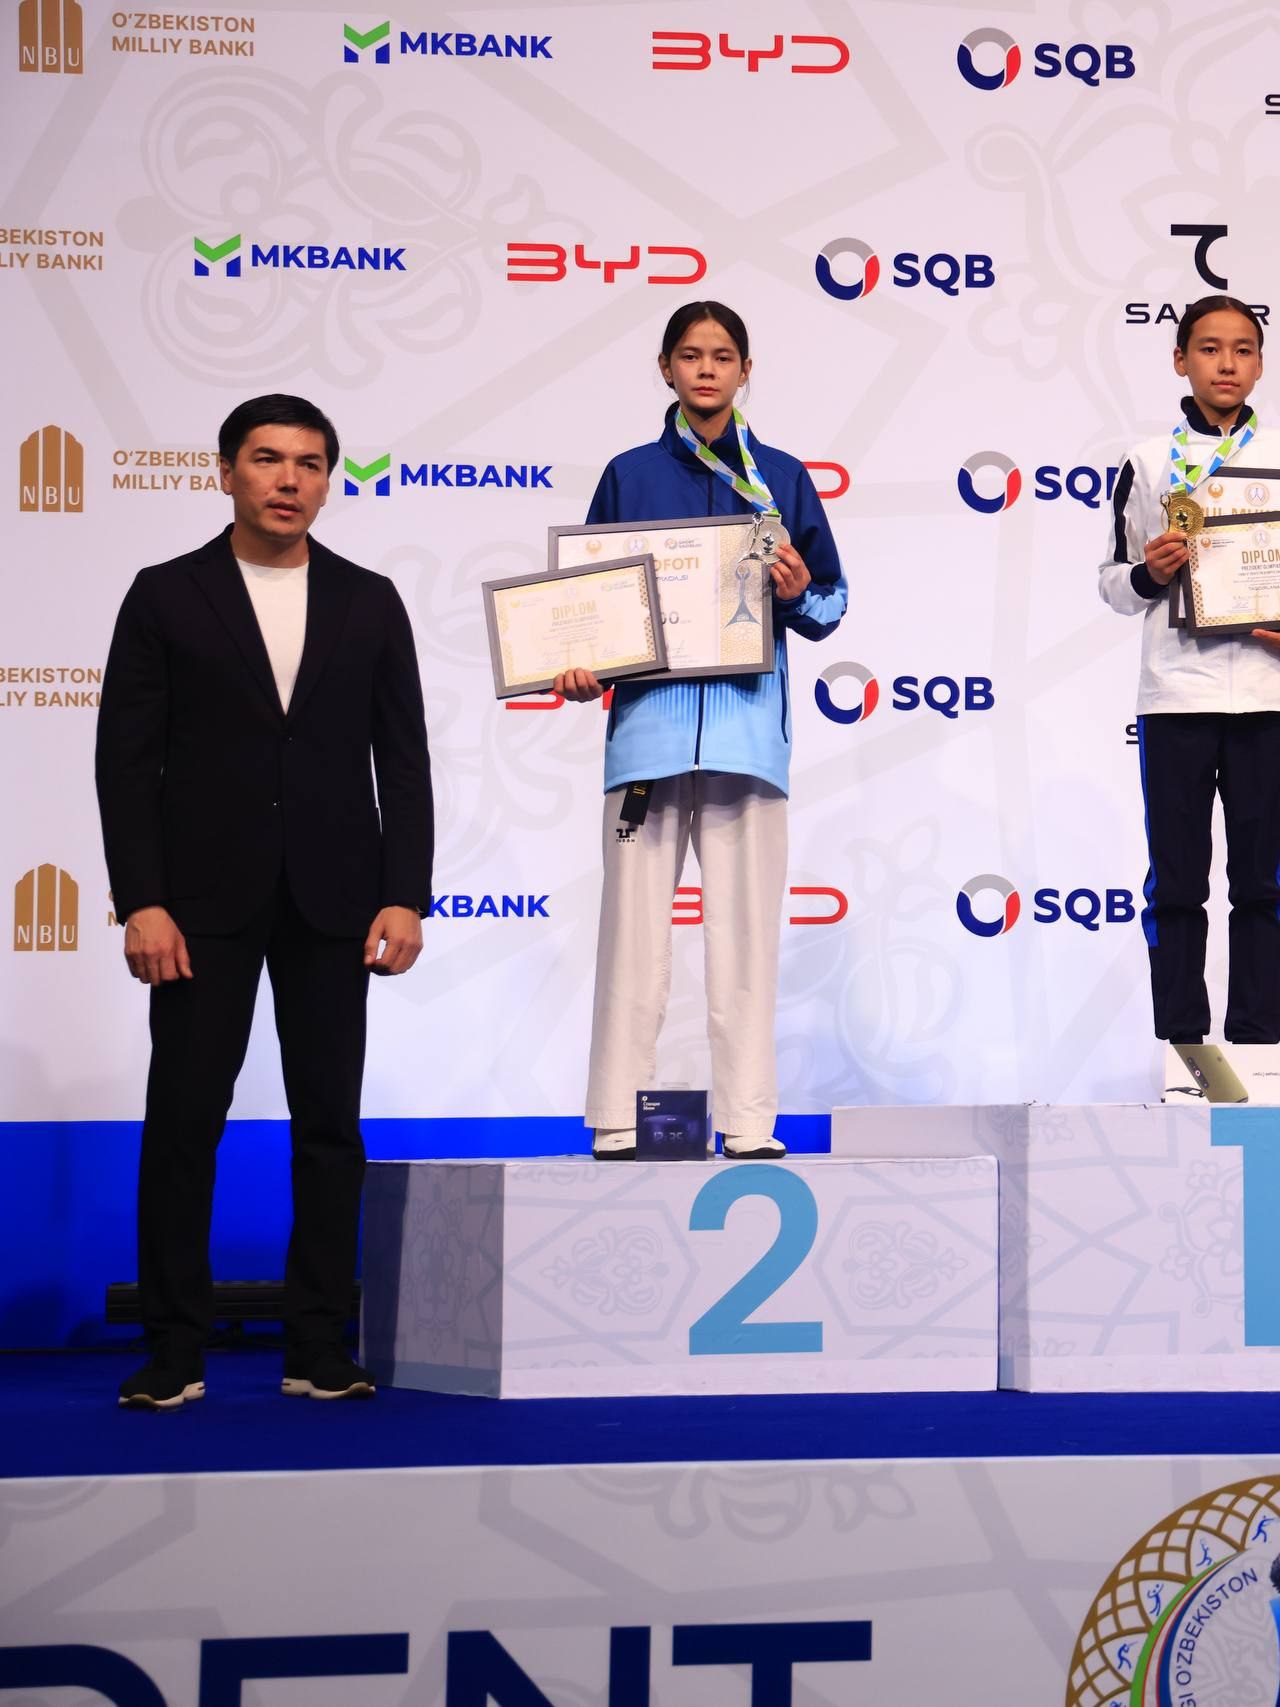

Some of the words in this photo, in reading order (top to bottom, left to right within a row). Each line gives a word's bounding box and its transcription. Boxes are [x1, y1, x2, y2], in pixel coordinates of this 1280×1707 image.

[112, 12, 254, 32] O'ZBEKISTON
[22, 45, 81, 68] NBU
[112, 36, 182, 53] MILLIY
[190, 39, 253, 56] BANKI
[401, 32, 552, 58] MKBANK
[652, 32, 849, 74] BYD
[1035, 43, 1135, 87] SQB
[37, 253, 102, 270] BANKI
[252, 245, 406, 270] MKBANK
[507, 243, 707, 284] BYD
[894, 253, 995, 296] SQB
[1126, 303, 1270, 325] SAR
[113, 450, 221, 468] O'ZBEKIST
[113, 474, 183, 490] MILLIY
[401, 464, 553, 488] MKBANK
[23, 484, 82, 506] NBU
[654, 557, 699, 571] OFOTI
[552, 600, 598, 620] DIPLOM
[34, 691, 100, 707] BANKI
[893, 676, 994, 719] SQB
[428, 895, 551, 919] KBANK
[1034, 888, 1133, 931] SQB
[17, 923, 76, 945] NBU
[689, 1165, 824, 1355] 2
[1176, 1568, 1259, 1686] O'ZBEKISTON
